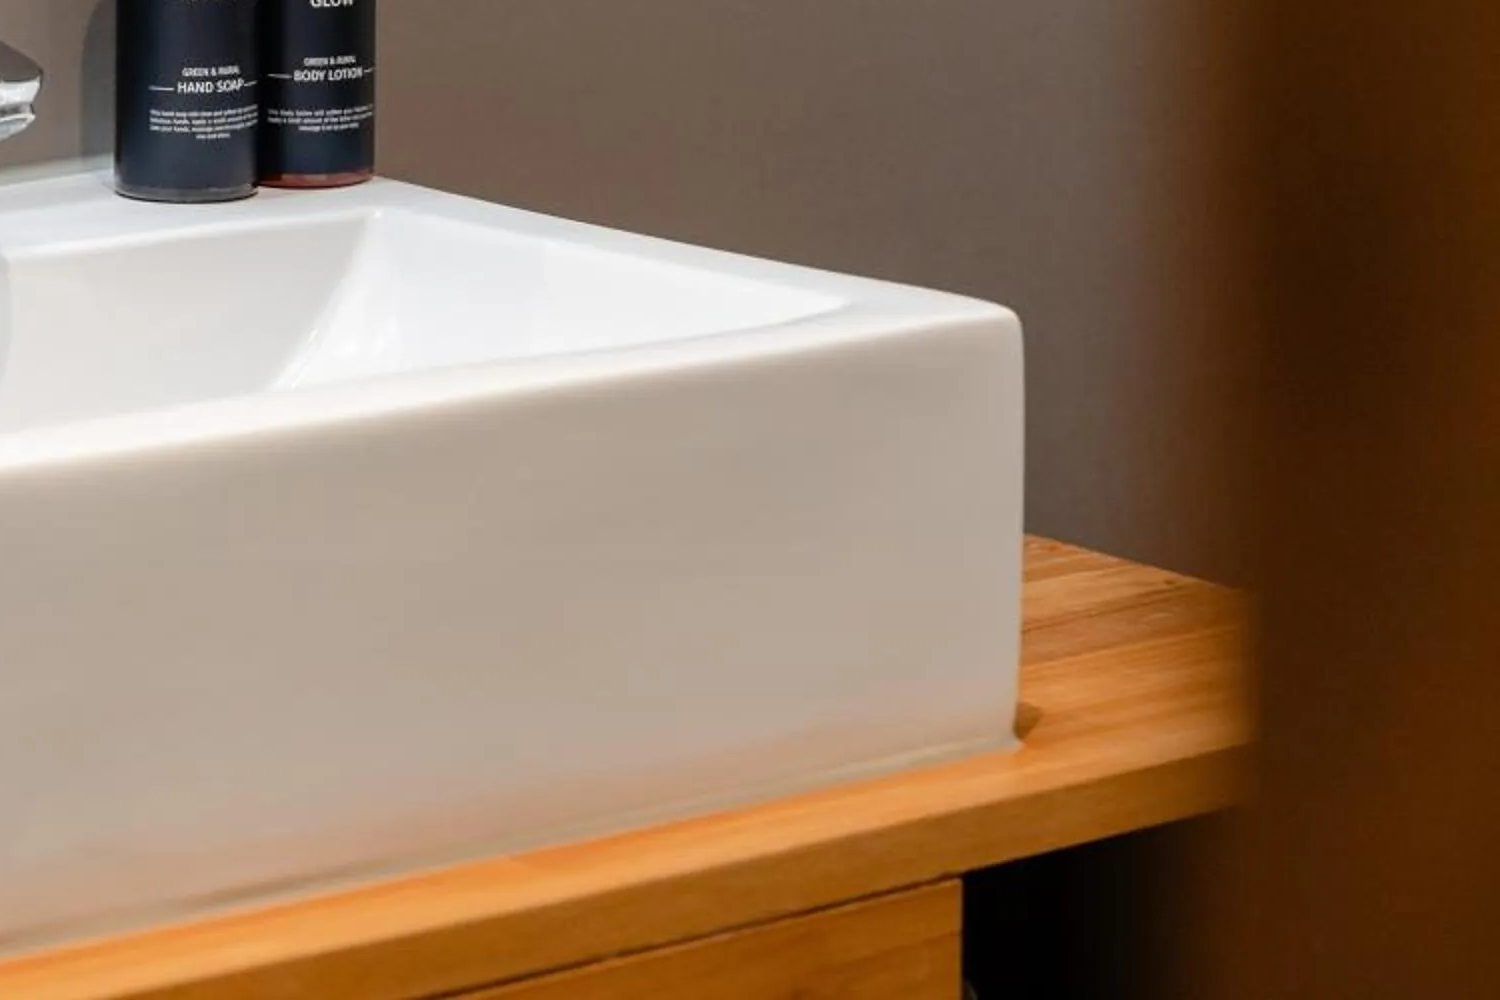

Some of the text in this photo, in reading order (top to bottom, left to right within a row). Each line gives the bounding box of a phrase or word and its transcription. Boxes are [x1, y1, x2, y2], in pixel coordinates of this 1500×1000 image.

[294, 66, 363, 81] BODY LOTION
[177, 77, 245, 94] HAND SOAP
